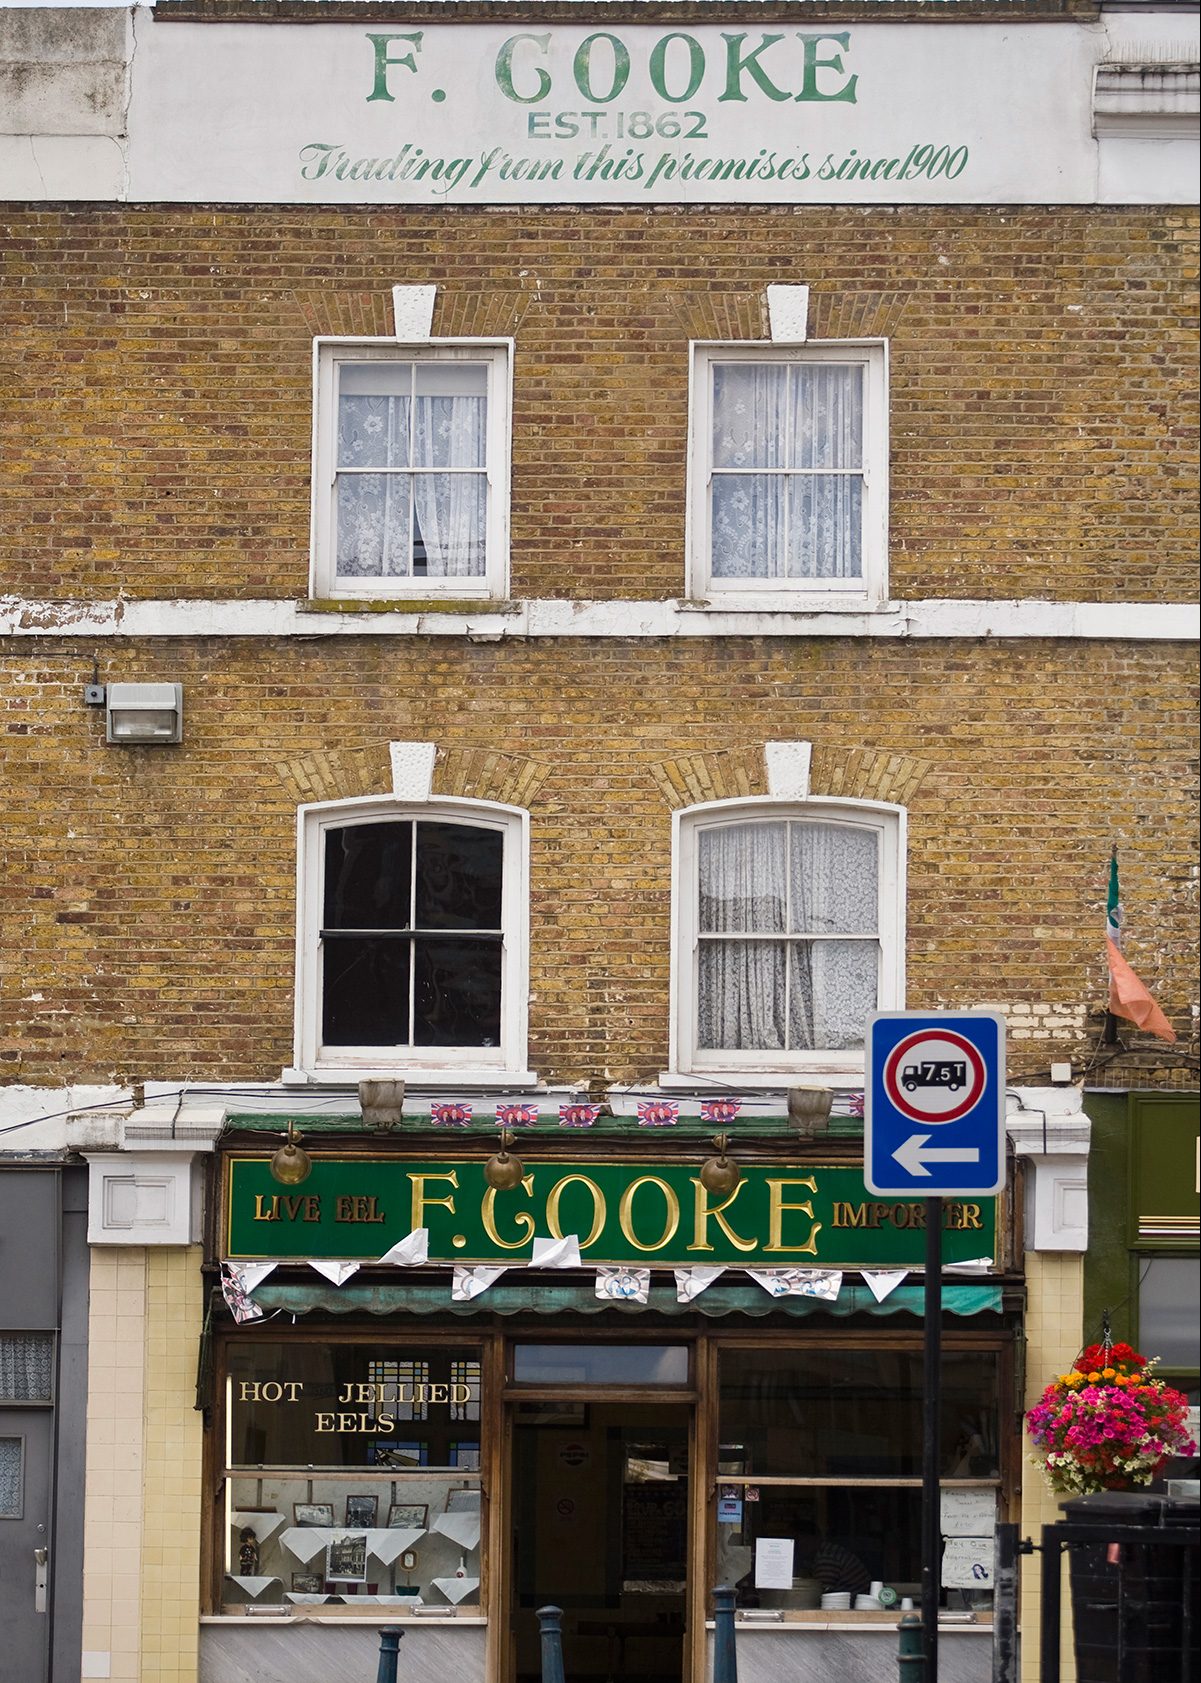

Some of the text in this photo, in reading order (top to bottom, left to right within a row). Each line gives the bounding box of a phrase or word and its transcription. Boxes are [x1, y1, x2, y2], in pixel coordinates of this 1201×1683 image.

[364, 30, 859, 105] F. COOKE
[299, 143, 474, 195] Trading
[468, 146, 565, 188] from
[573, 144, 645, 181] this
[643, 149, 811, 189] premises
[253, 1194, 385, 1223] LIVE EEL
[406, 1169, 823, 1256] F. COOKE
[831, 1201, 984, 1230] IMPORER
[239, 1381, 471, 1404] HOT JELLIED
[314, 1412, 395, 1433] EELS
